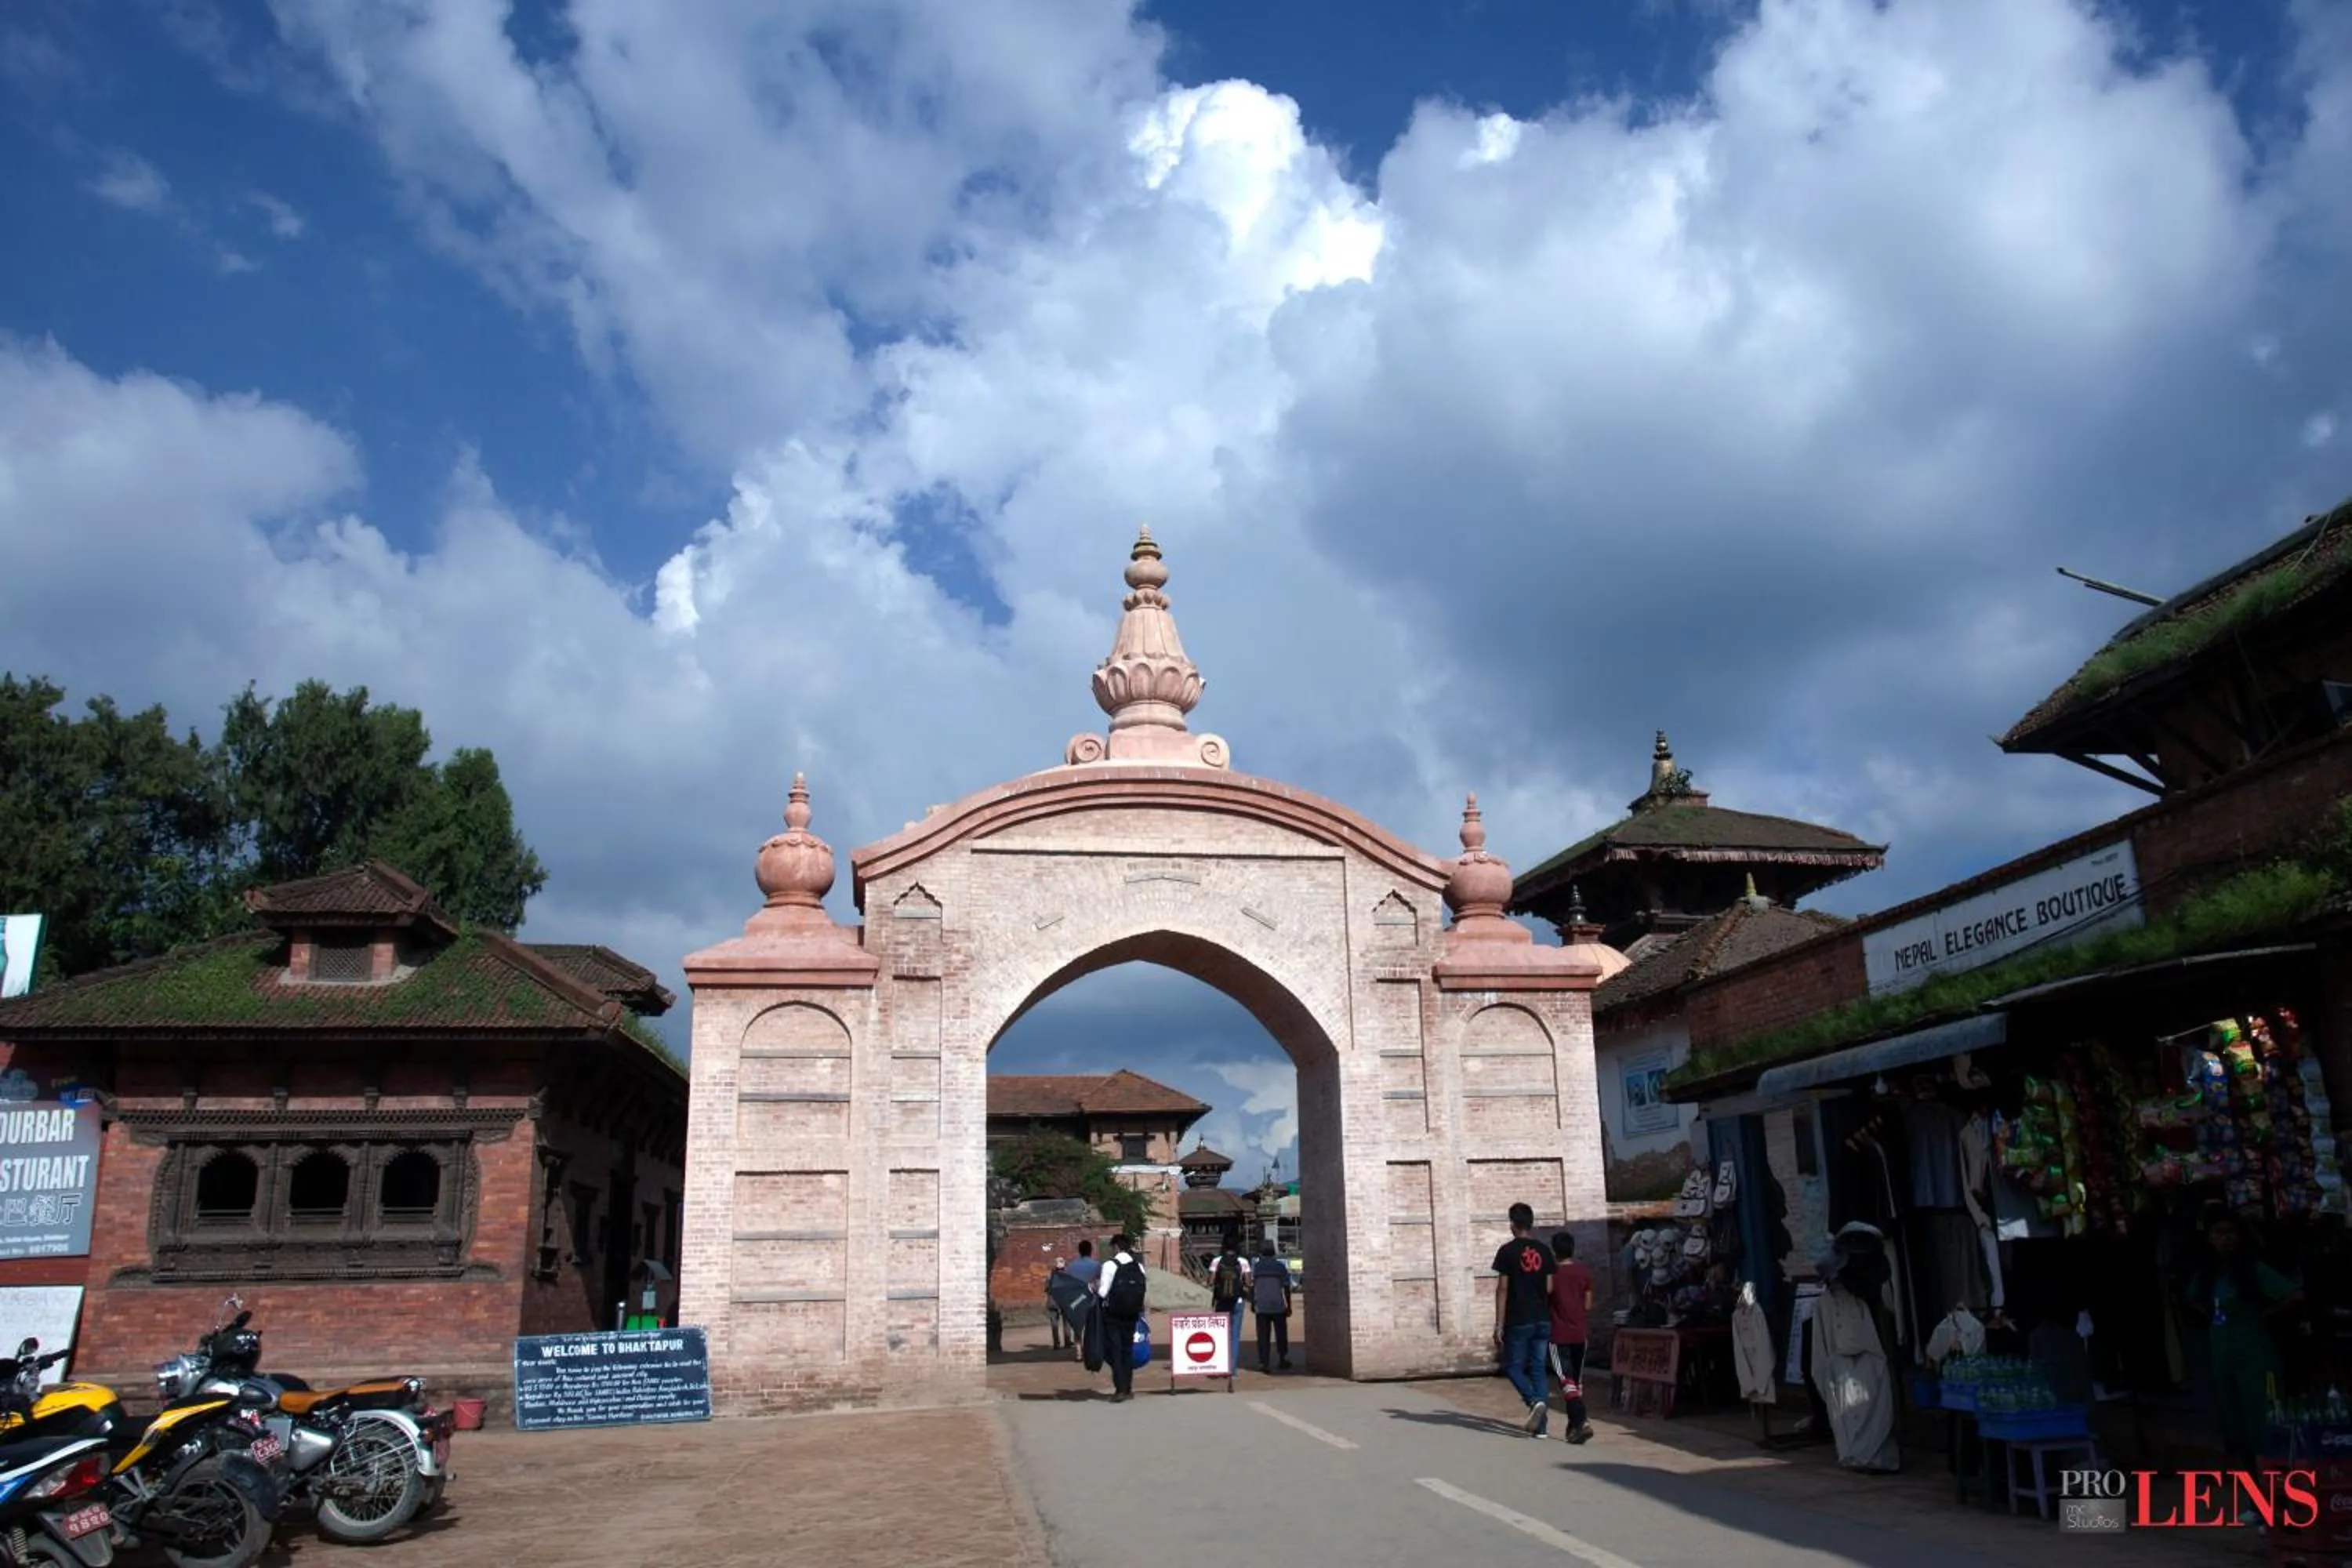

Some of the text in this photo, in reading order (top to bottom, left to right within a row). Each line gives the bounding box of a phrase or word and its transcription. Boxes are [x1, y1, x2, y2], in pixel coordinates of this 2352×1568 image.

[1894, 873, 2127, 972] NEPAL ELEGANCE BOUTIQUE
[541, 1338, 684, 1358] WELCOME TO BHAKTAPUR
